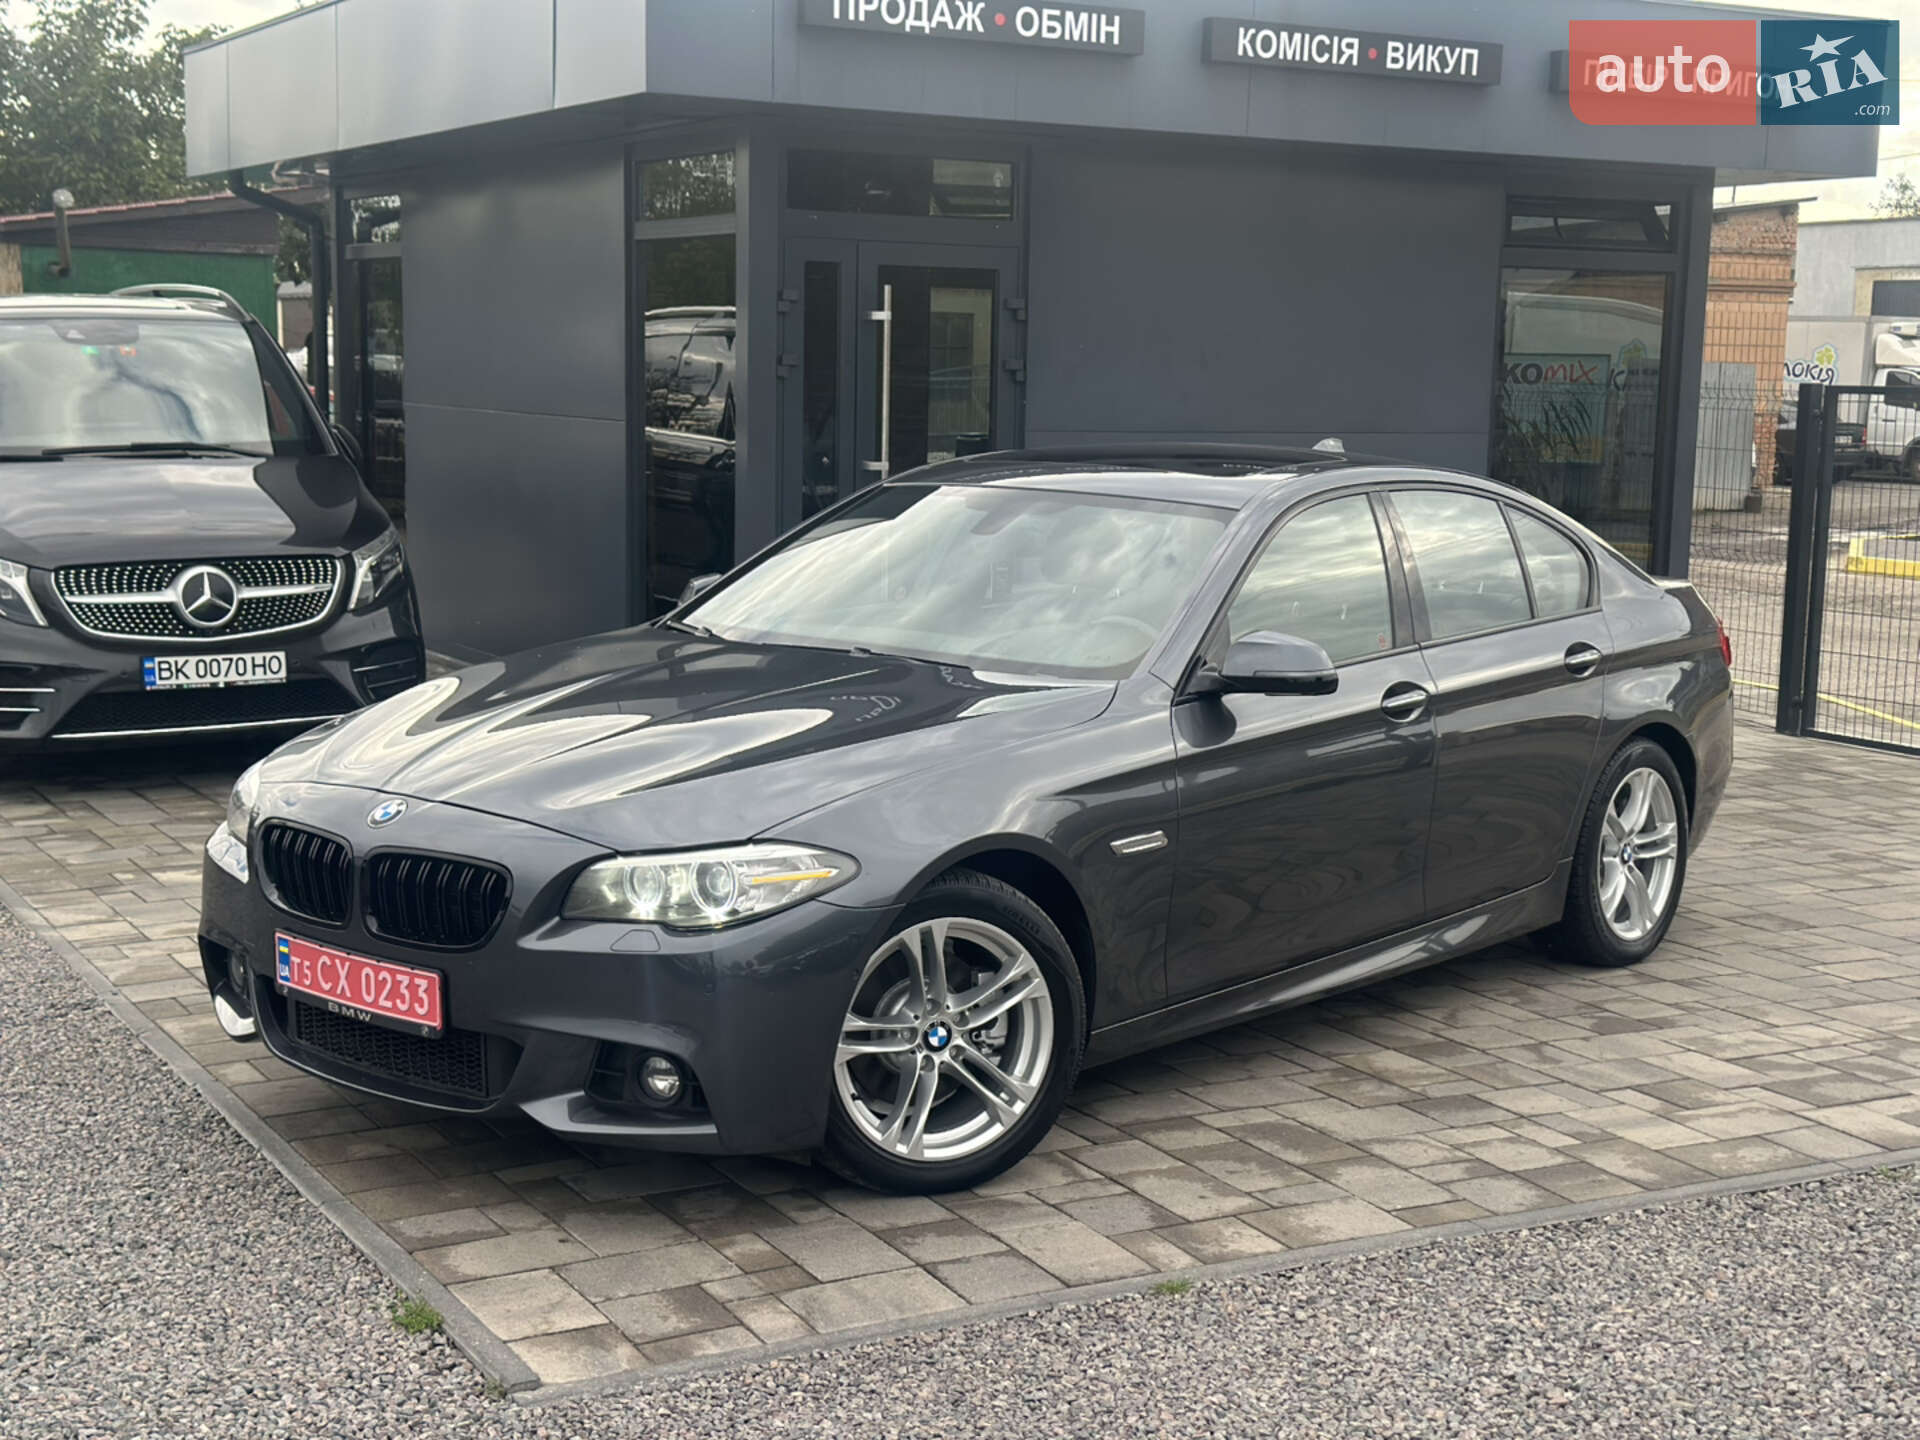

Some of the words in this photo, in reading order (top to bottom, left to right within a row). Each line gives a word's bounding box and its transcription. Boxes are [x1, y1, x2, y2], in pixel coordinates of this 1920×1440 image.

[832, 0, 985, 33] ПРОДАЖ
[1015, 6, 1120, 45] ОБМІН
[1237, 27, 1359, 66] КОМІСІЯ
[1386, 41, 1480, 76] ВИКУП
[195, 657, 247, 679] 0070
[328, 1001, 373, 1022] BMW
[361, 967, 430, 1016] 0233
